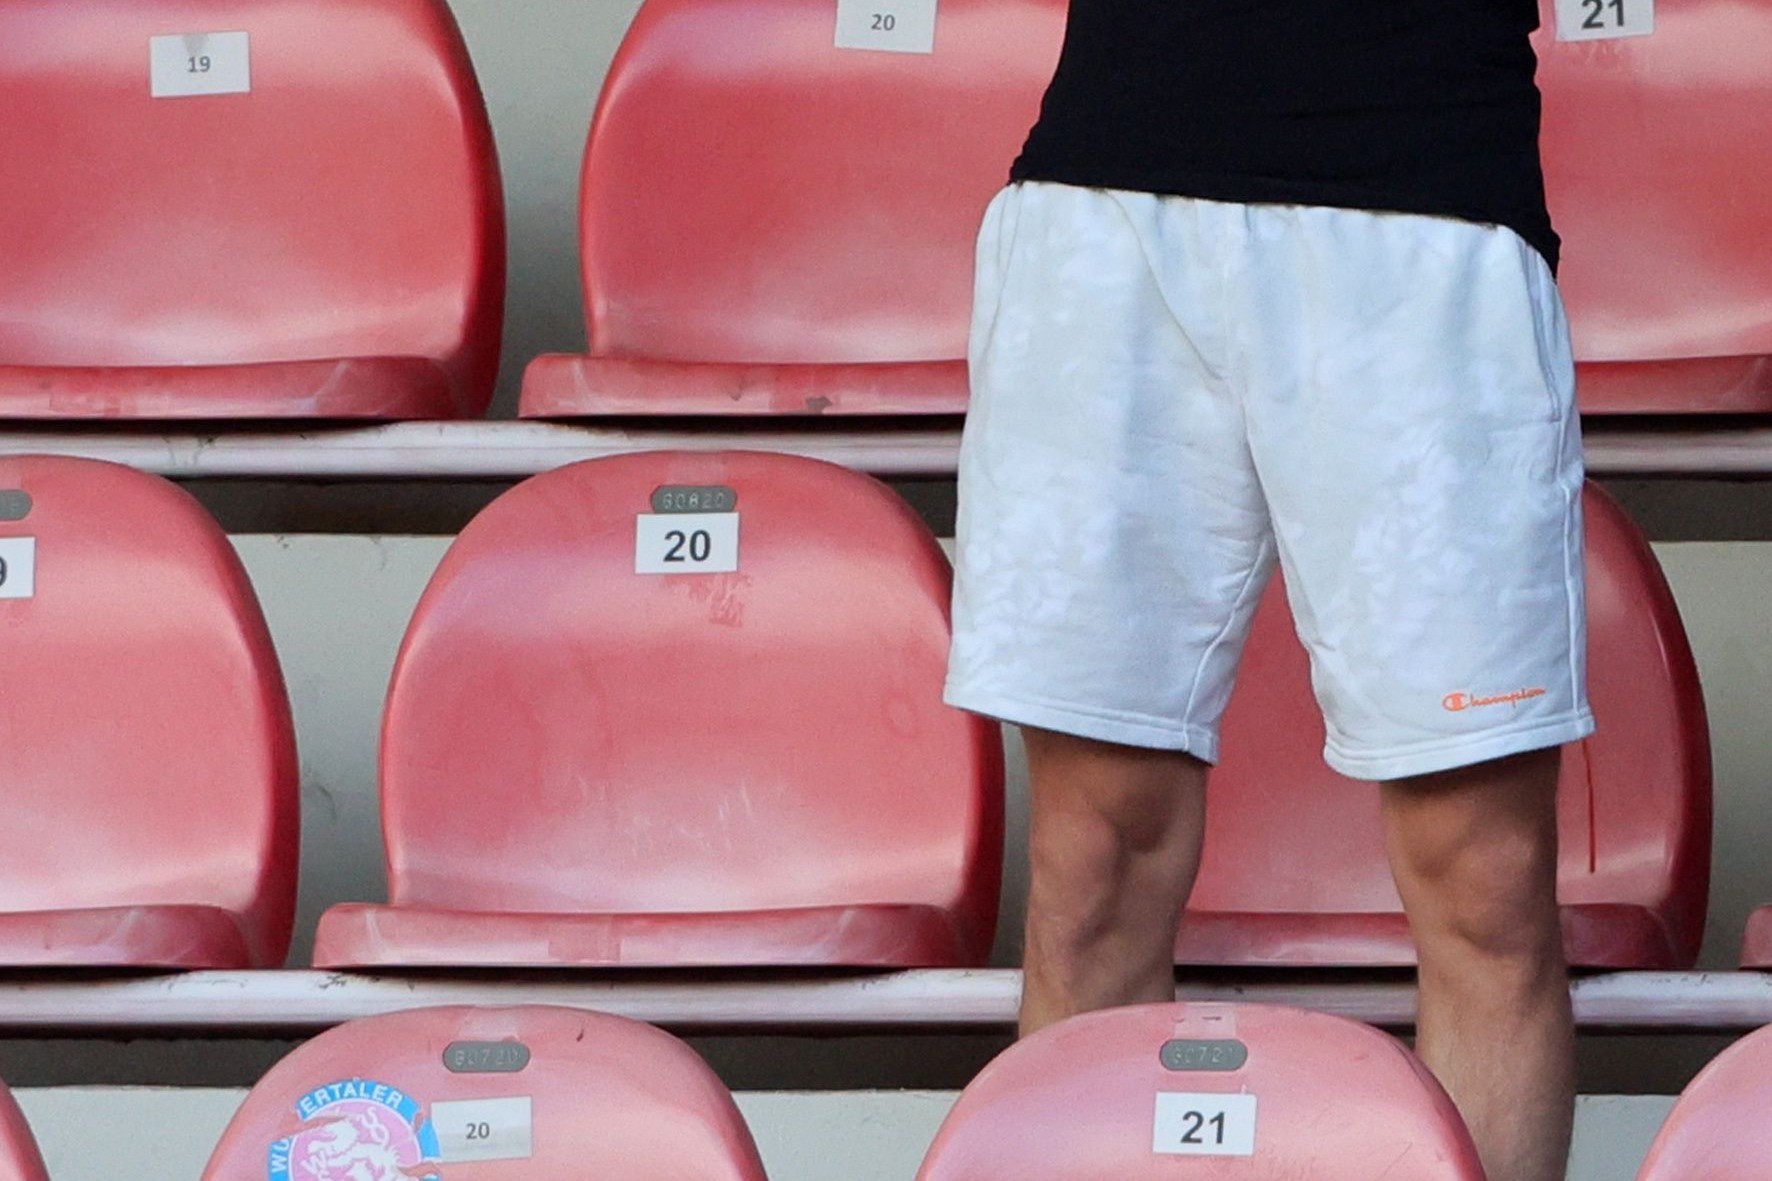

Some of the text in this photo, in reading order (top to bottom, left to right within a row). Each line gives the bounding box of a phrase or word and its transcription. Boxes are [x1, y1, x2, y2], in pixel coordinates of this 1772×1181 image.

[871, 13, 896, 31] 20
[188, 55, 211, 74] 19
[663, 529, 711, 562] 20
[1443, 687, 1545, 713] Champion
[300, 1081, 404, 1115] ERTALER
[466, 1122, 490, 1140] 20
[1180, 1110, 1225, 1145] 21
